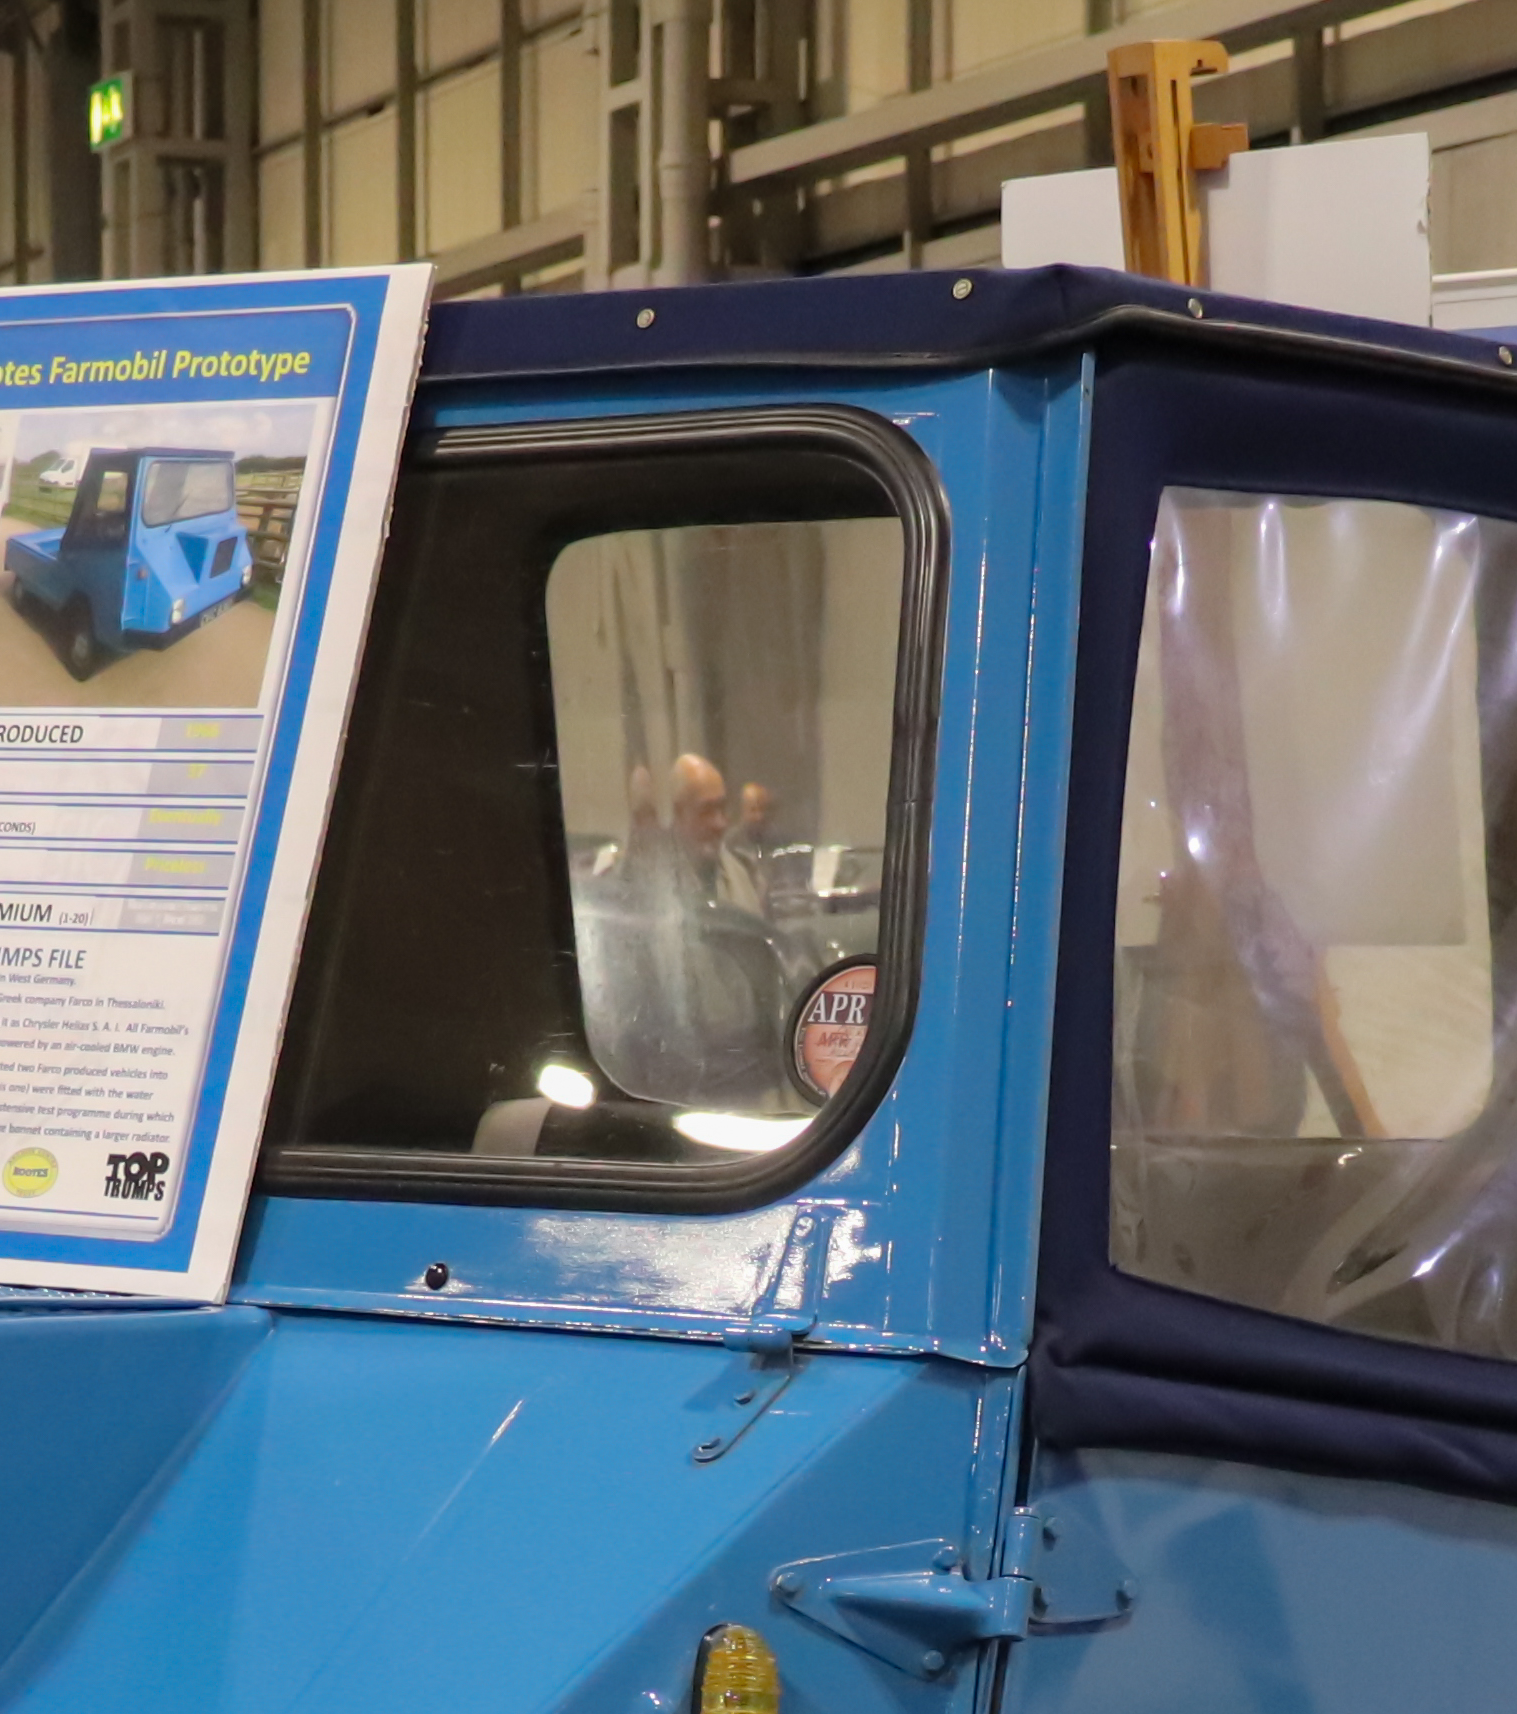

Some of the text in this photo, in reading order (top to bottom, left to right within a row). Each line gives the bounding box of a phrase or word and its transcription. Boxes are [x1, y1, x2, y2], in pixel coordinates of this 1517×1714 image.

[48, 350, 168, 385] Farmobil
[172, 350, 312, 382] Prototype
[47, 947, 87, 970] FILE
[9, 972, 32, 984] West
[24, 995, 67, 1009] company
[68, 995, 93, 1007] Farco
[94, 996, 104, 1007] in
[807, 992, 867, 1025] APR
[0, 1016, 9, 1029] it
[20, 1017, 60, 1030] Chrysler
[37, 1037, 49, 1051] by
[50, 1041, 62, 1050] an
[113, 1042, 140, 1054] BMW
[17, 1062, 35, 1073] two
[36, 1062, 62, 1074] Farco
[63, 1065, 109, 1077] produced
[110, 1066, 147, 1079] vehicles
[149, 1068, 168, 1080] into
[0, 1081, 7, 1092] is
[32, 1084, 55, 1094] were
[57, 1083, 83, 1096] fitted
[84, 1086, 105, 1097] with
[108, 1087, 124, 1099] the
[126, 1090, 153, 1100] water
[37, 1104, 56, 1115] test
[56, 1107, 111, 1119] programme
[113, 1108, 145, 1123] during
[146, 1110, 175, 1122] which
[8, 1122, 42, 1135] bonnet
[43, 1127, 93, 1141] containing
[94, 1130, 100, 1139] a
[102, 1128, 130, 1142] larger
[105, 1151, 170, 1184] TOP
[104, 1179, 166, 1201] TRUMPS
